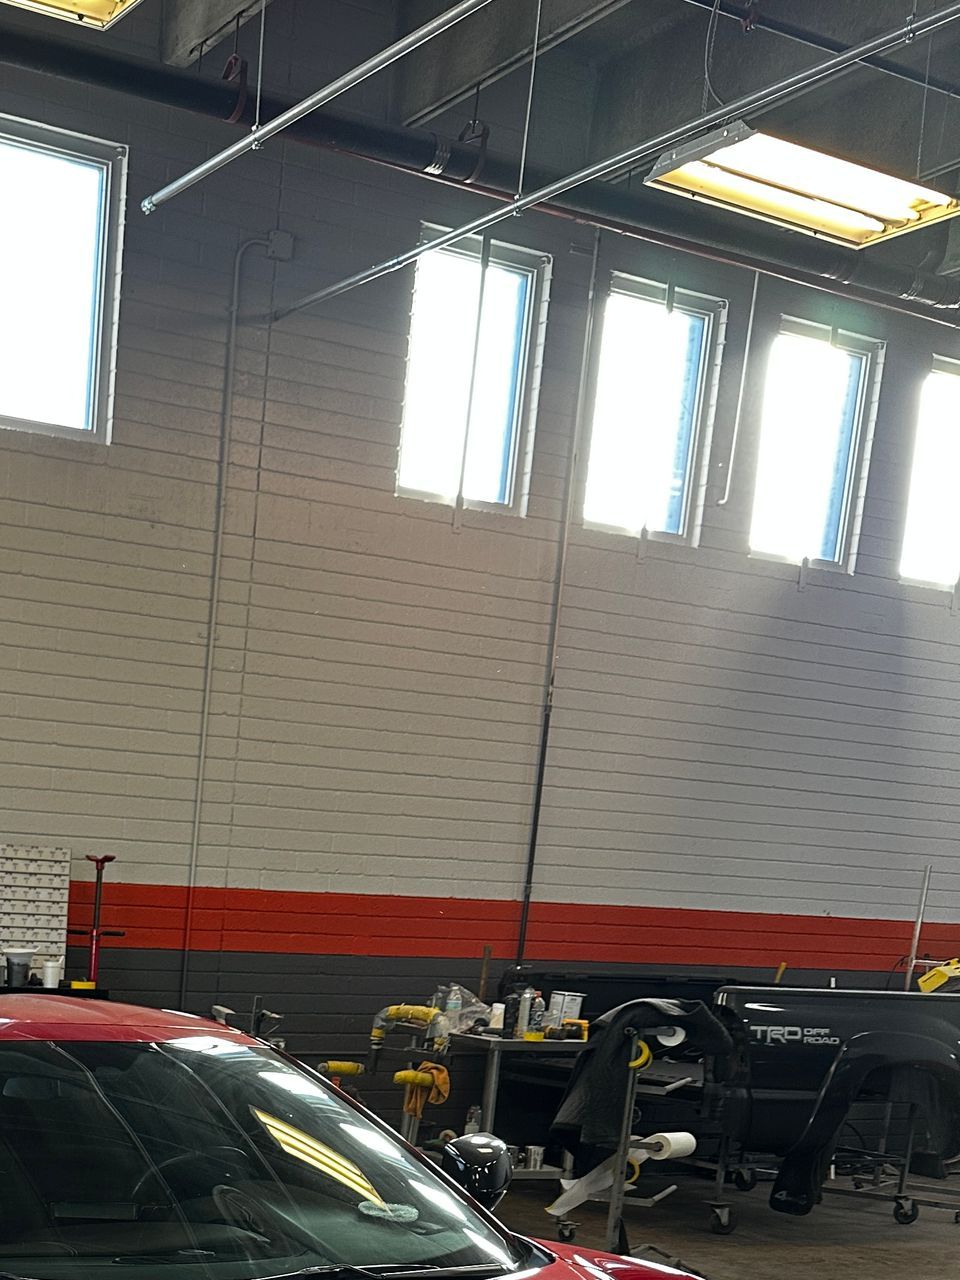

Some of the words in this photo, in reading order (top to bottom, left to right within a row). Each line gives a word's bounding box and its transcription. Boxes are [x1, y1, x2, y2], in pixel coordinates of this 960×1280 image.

[749, 1025, 802, 1044] TRD
[803, 1027, 830, 1036] OFF
[803, 1036, 840, 1045] ROAD
